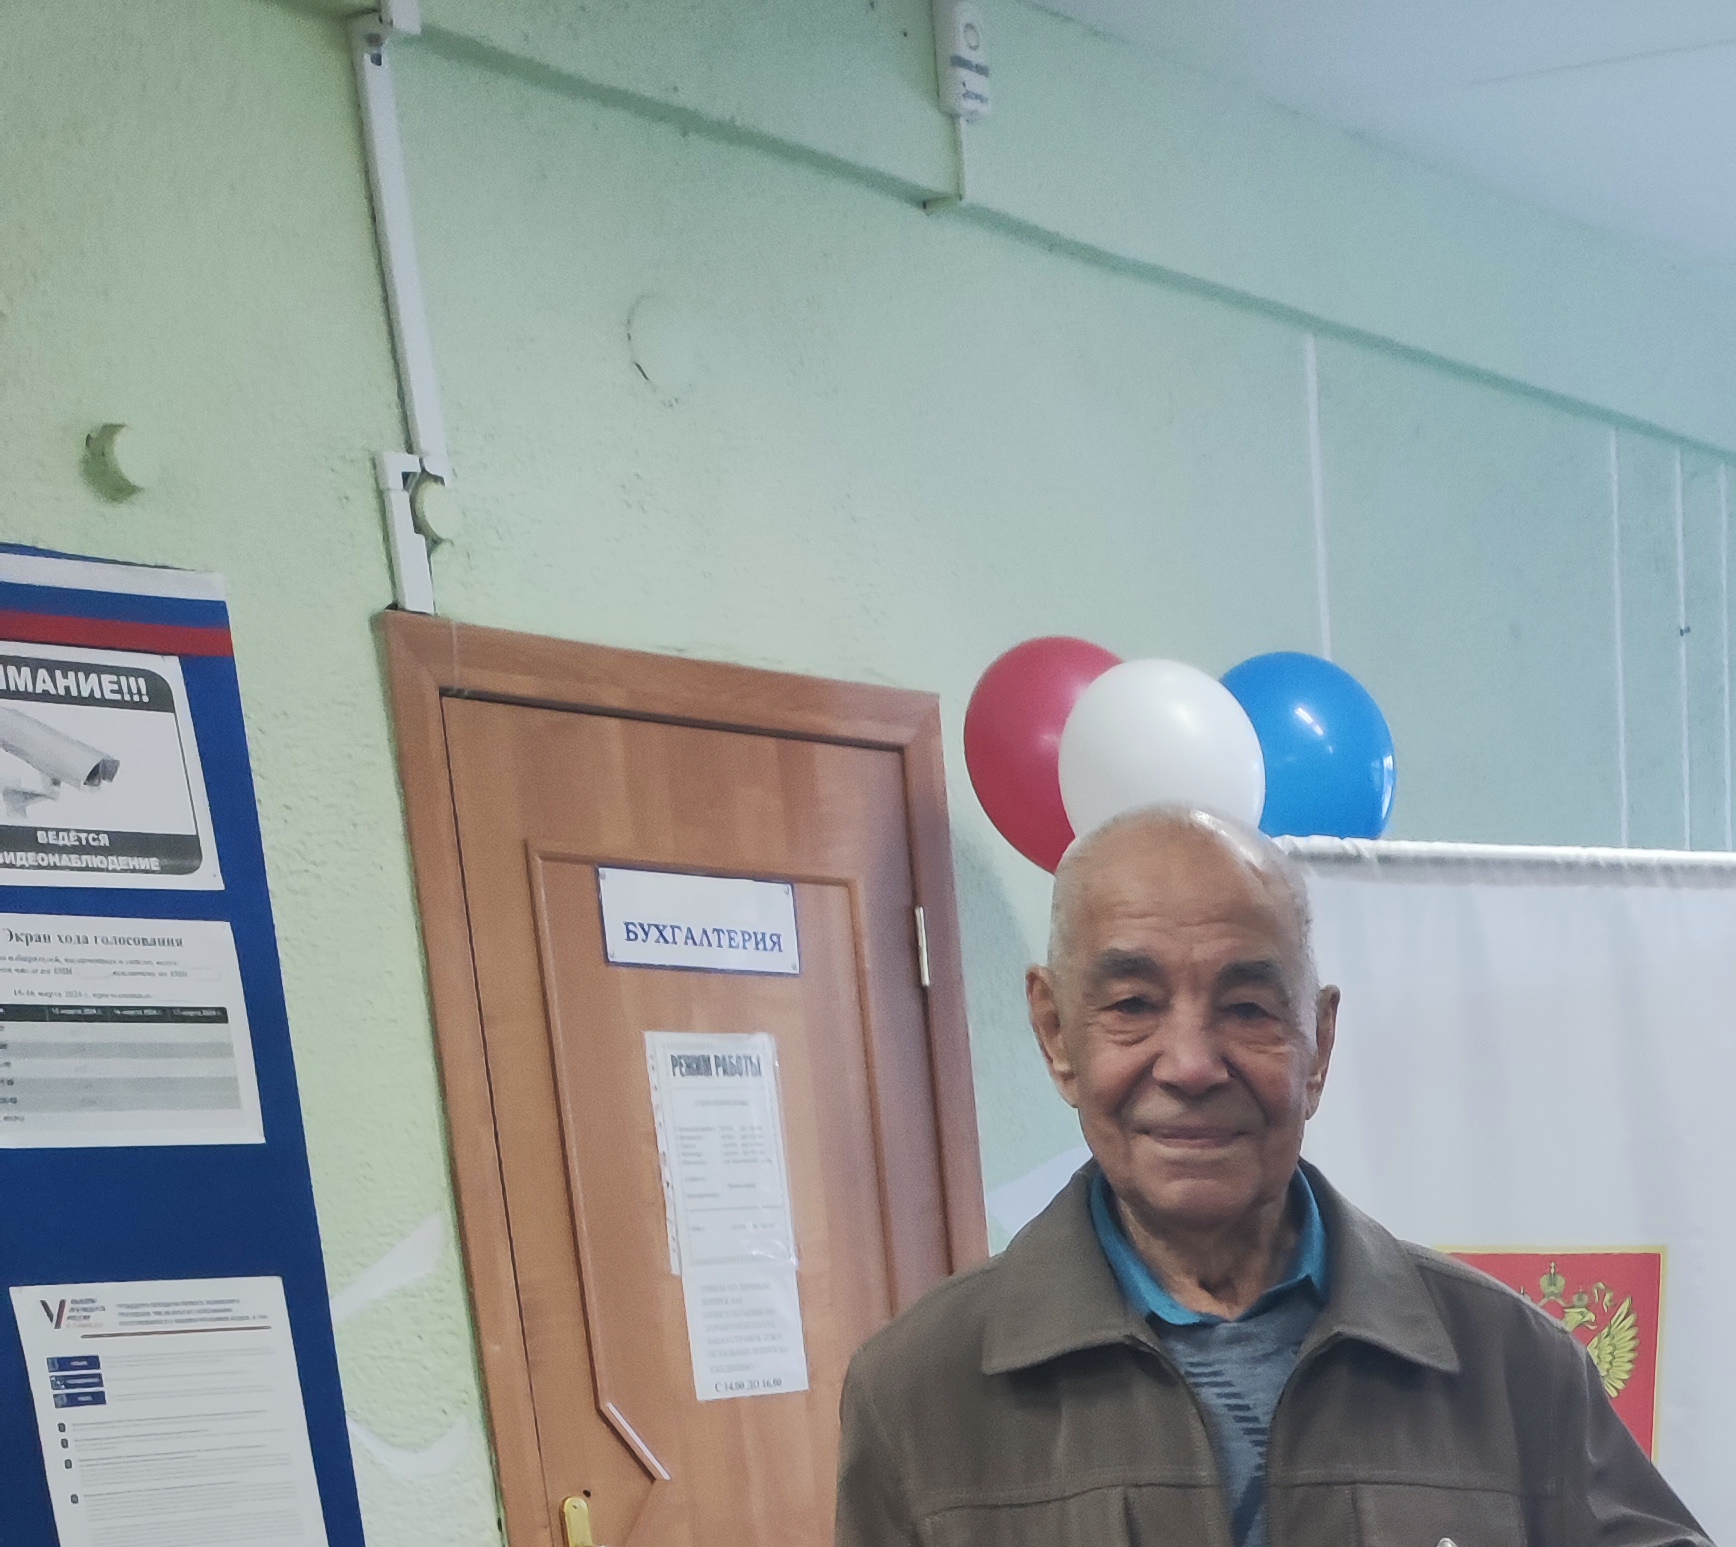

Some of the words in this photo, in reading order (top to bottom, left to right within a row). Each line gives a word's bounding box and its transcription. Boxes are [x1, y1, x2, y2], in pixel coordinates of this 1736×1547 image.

[2, 928, 51, 947] Экран
[57, 934, 89, 945] хода
[93, 935, 184, 948] голосования
[623, 921, 783, 953] БУХГАЛТЕРИЯ
